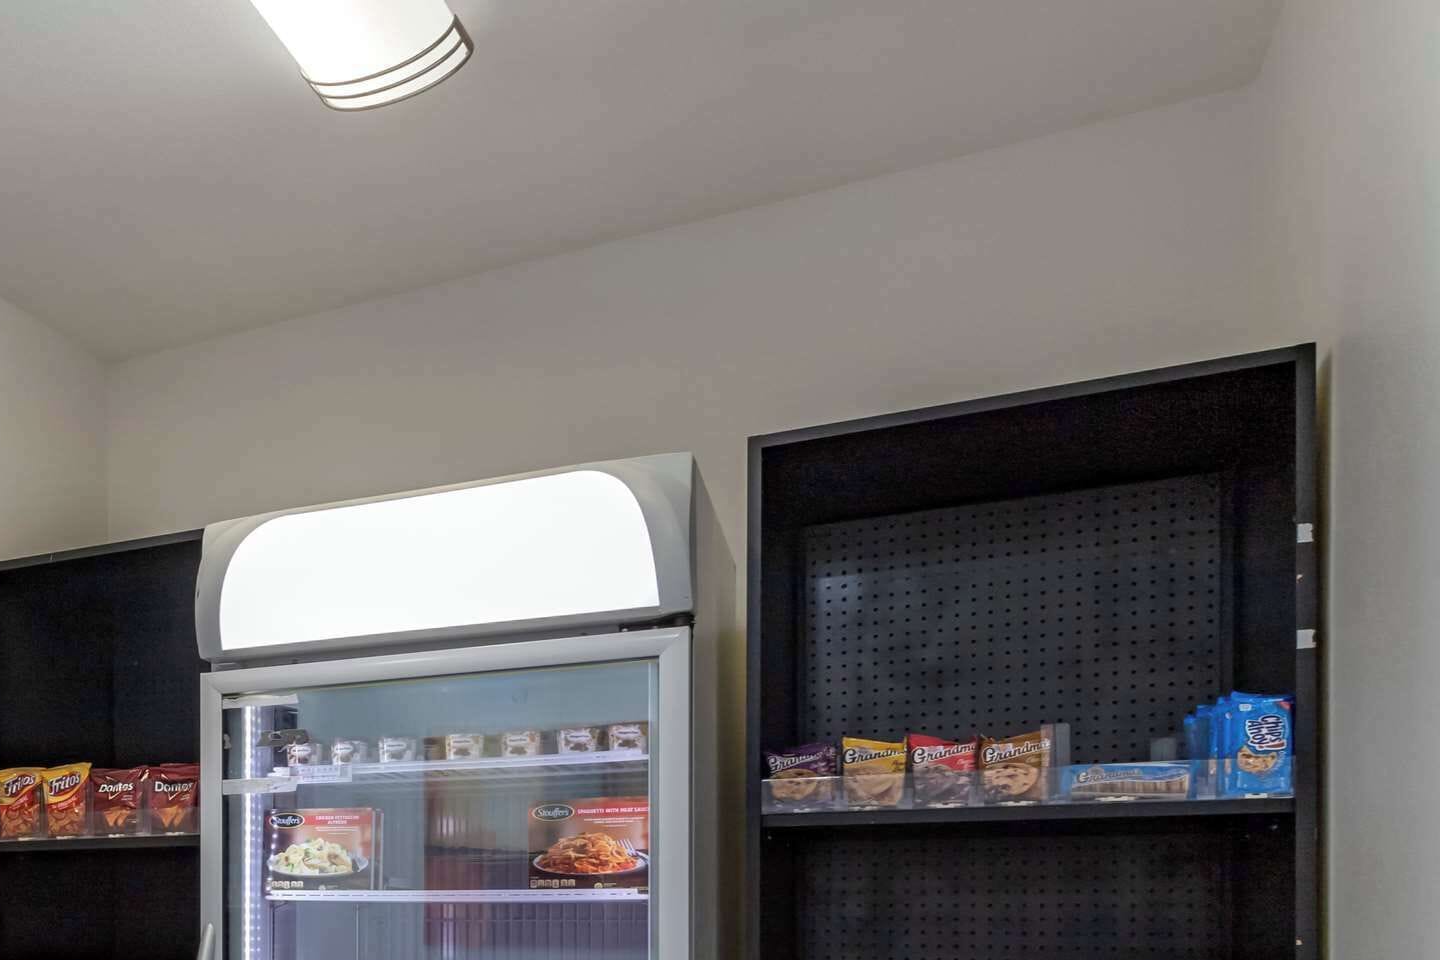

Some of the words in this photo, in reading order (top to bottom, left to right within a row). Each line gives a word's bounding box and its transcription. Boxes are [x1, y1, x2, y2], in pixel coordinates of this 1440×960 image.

[1260, 716, 1282, 742] Chips
[5, 774, 35, 796] Fritos
[48, 773, 80, 796] Fritos
[99, 781, 133, 794] Doritos
[154, 781, 193, 793] Doritos
